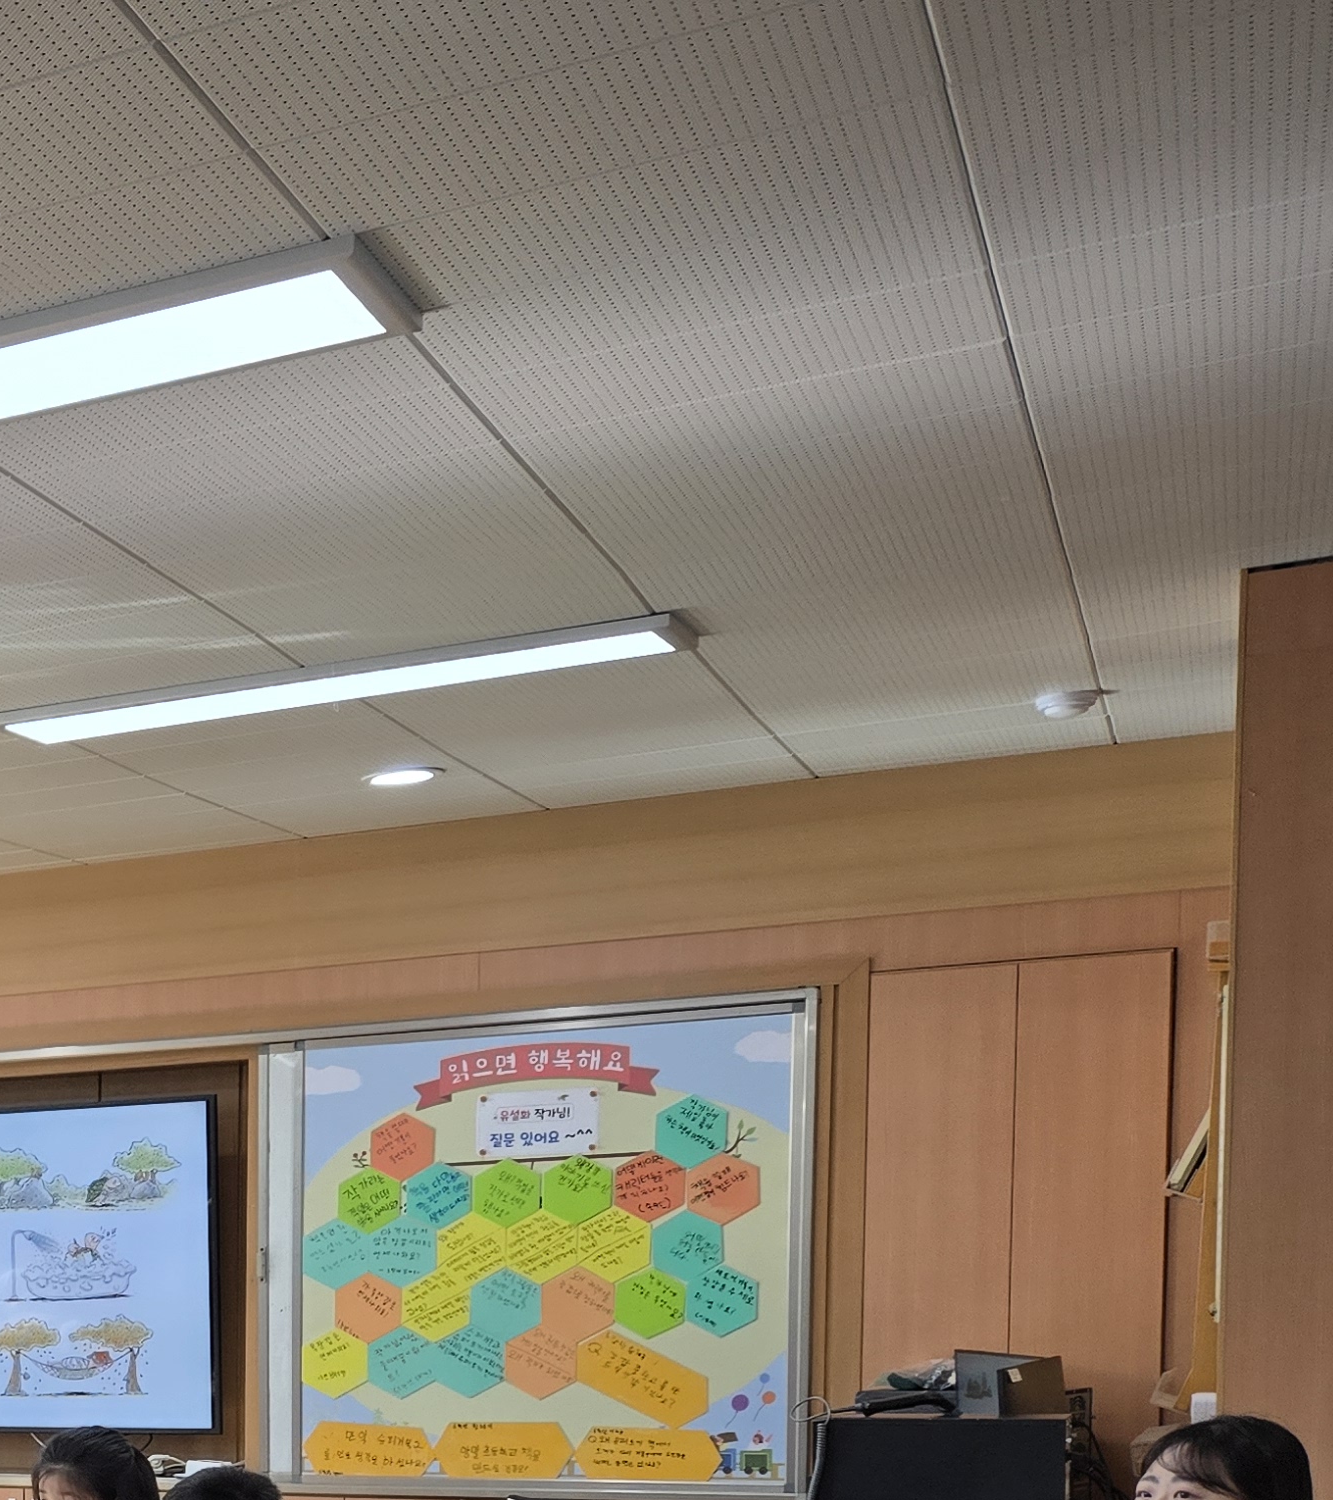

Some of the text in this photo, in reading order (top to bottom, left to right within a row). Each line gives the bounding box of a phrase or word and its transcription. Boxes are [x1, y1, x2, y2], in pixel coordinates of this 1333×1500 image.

[448, 1048, 625, 1085] 읽으면 행복해요
[499, 1107, 571, 1122] 유설화 작가님!
[489, 1132, 516, 1148] 질문
[520, 1130, 560, 1147] 있어요
